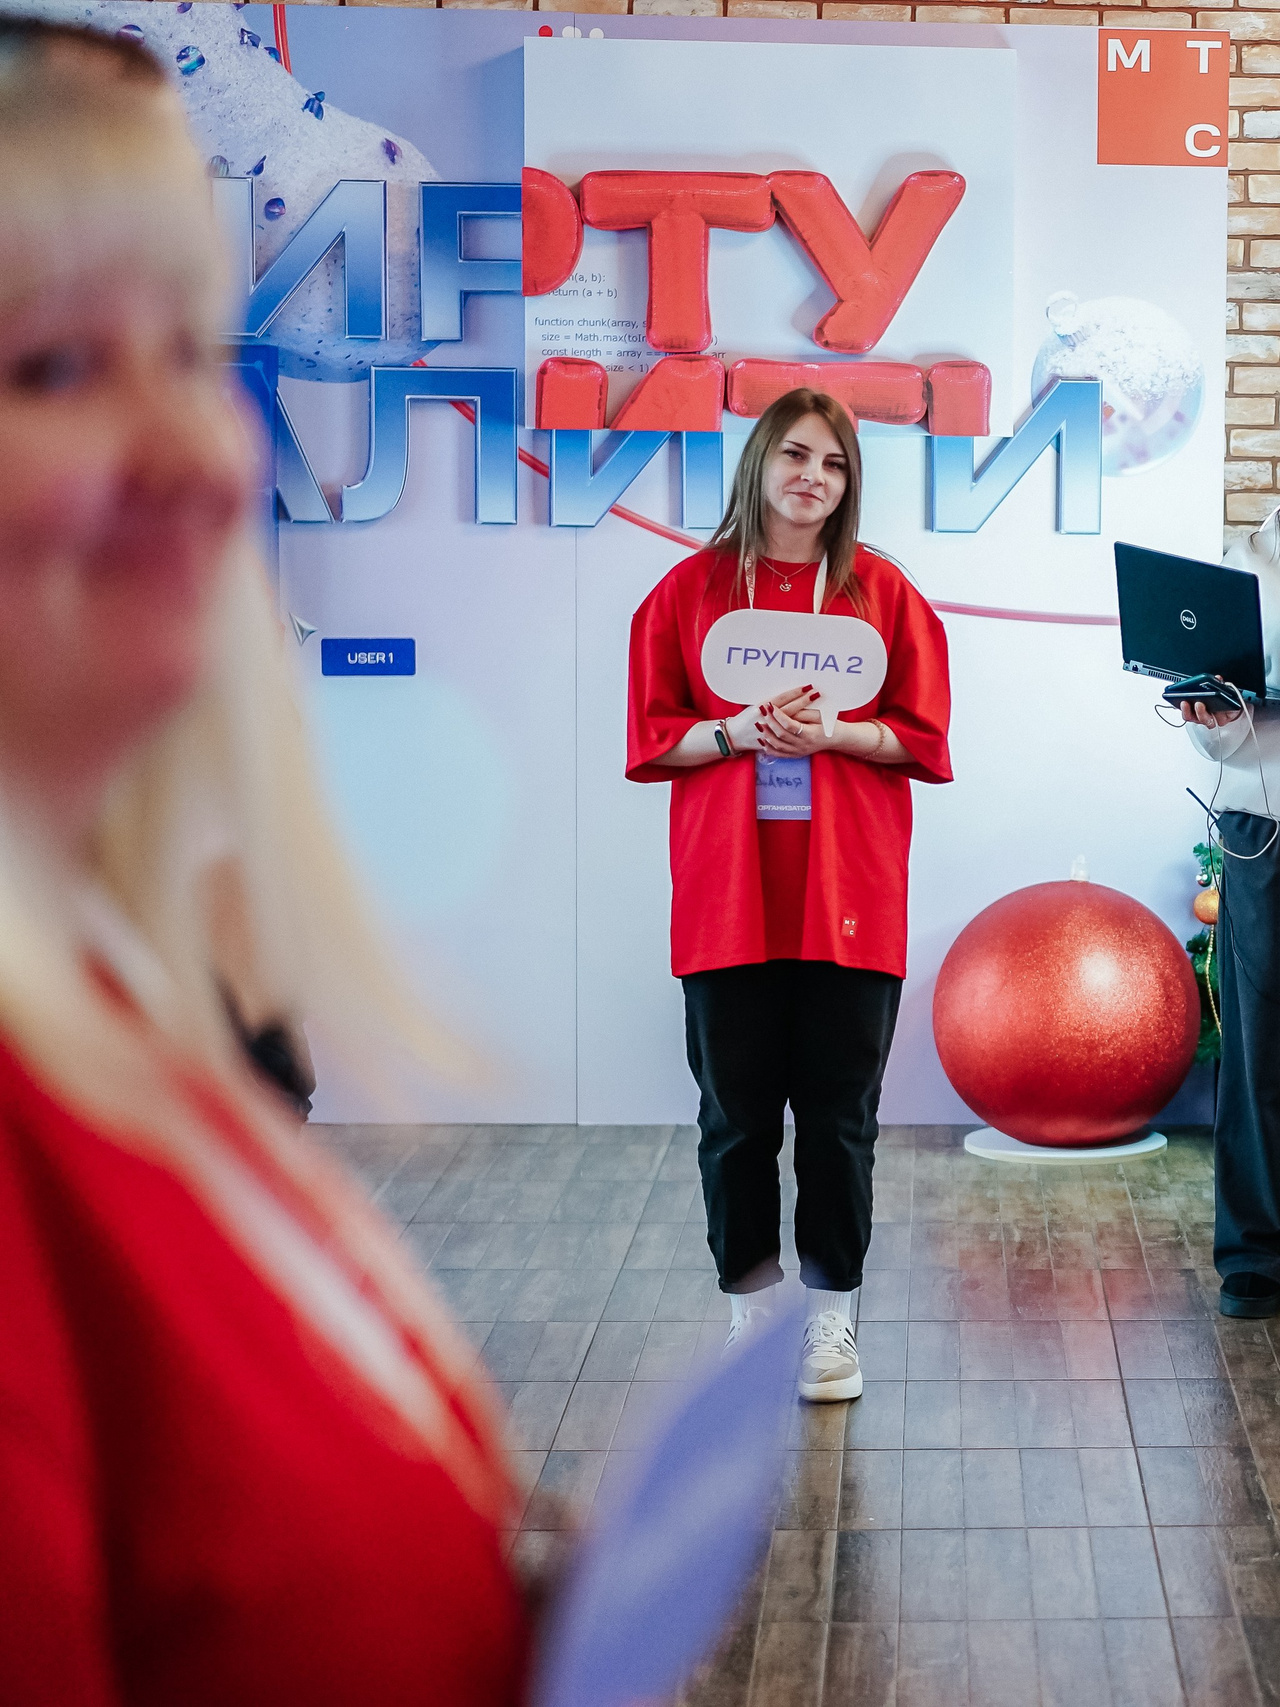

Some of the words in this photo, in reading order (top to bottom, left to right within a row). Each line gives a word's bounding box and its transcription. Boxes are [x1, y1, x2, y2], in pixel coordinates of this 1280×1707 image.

[607, 288, 618, 299] b)
[534, 316, 574, 326] function
[577, 317, 640, 329] chunk(array,
[541, 332, 561, 342] size
[574, 332, 648, 344] Math.max(toIn
[541, 348, 568, 357] const
[571, 347, 602, 359] length
[616, 350, 643, 359] array
[605, 363, 625, 373] size
[347, 652, 386, 665] USER
[389, 652, 394, 664] 1
[726, 646, 840, 673] ГРУППА
[846, 655, 864, 674] 2
[757, 804, 812, 812] ОРГАНИЗАТОР
